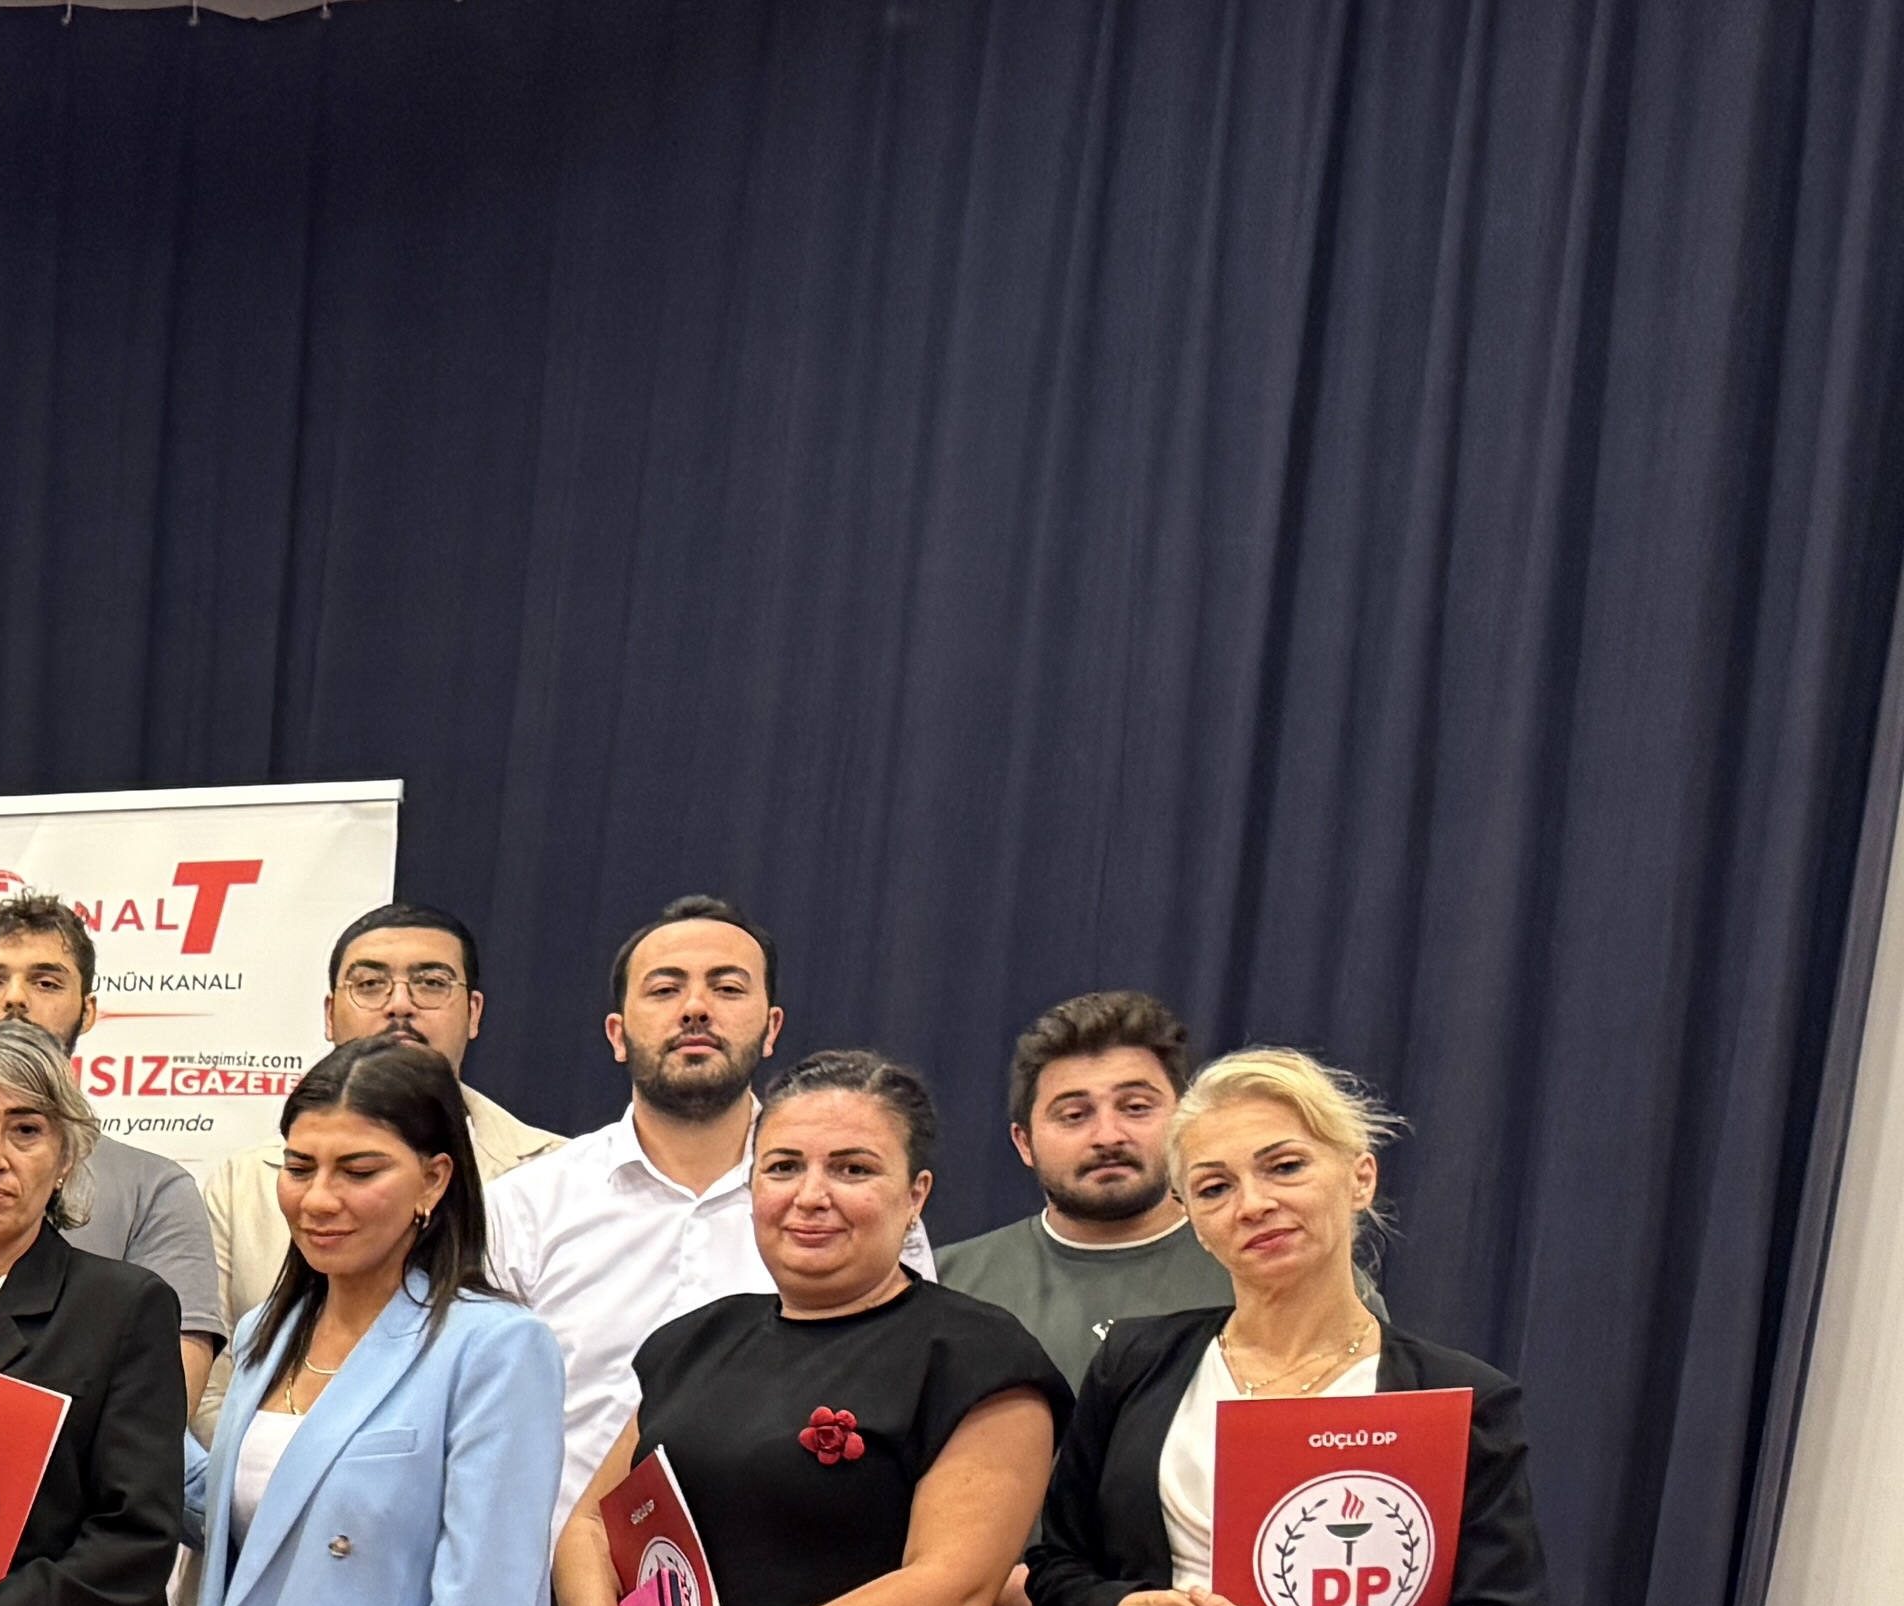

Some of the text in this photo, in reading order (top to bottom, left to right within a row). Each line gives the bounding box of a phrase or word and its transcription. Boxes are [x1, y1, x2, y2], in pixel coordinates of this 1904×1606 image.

[160, 972, 242, 991] KANALI
[123, 1113, 214, 1136] yanında
[1308, 1430, 1398, 1450] GÜÇLÜ DP
